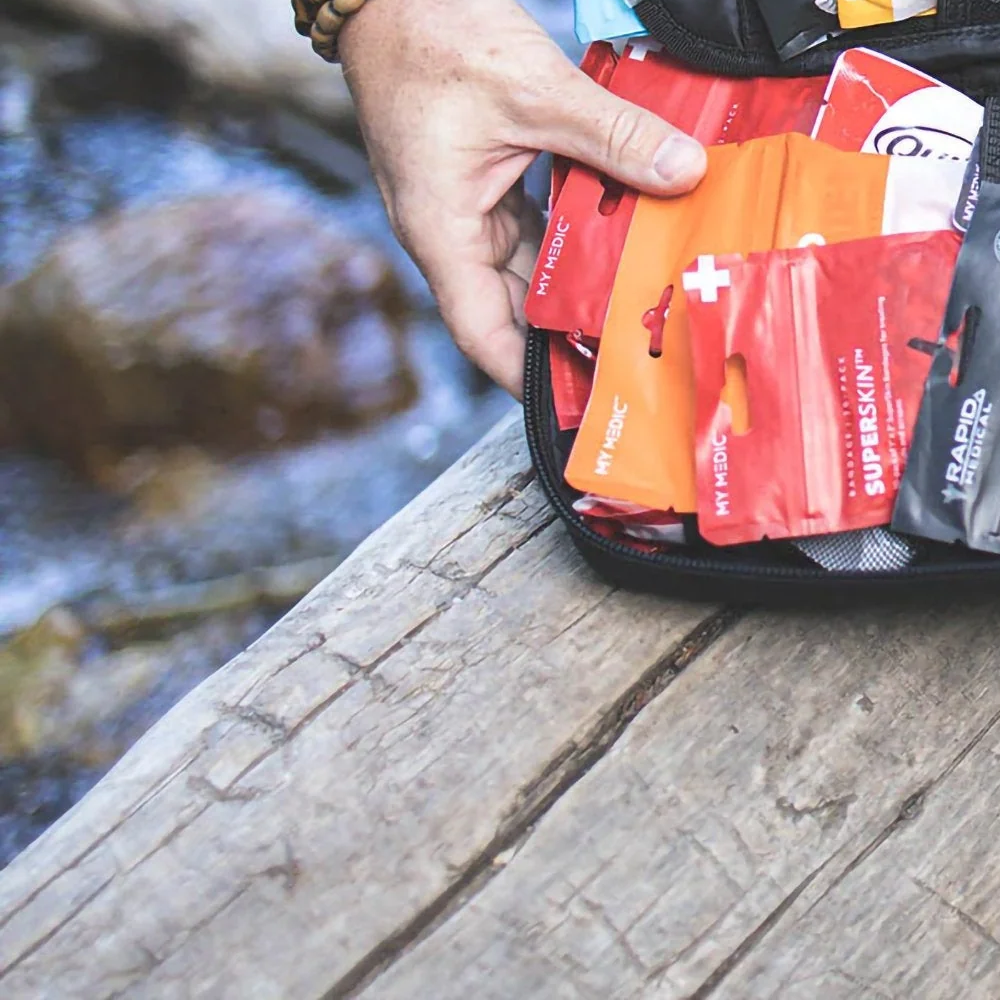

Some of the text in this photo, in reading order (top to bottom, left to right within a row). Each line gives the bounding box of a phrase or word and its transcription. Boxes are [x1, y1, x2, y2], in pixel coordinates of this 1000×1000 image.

[535, 271, 553, 296] MY
[593, 450, 613, 476] MY
[711, 429, 731, 517] MY MEDIC
[945, 397, 978, 483] RAPID
[965, 402, 993, 485] MEDICAL
